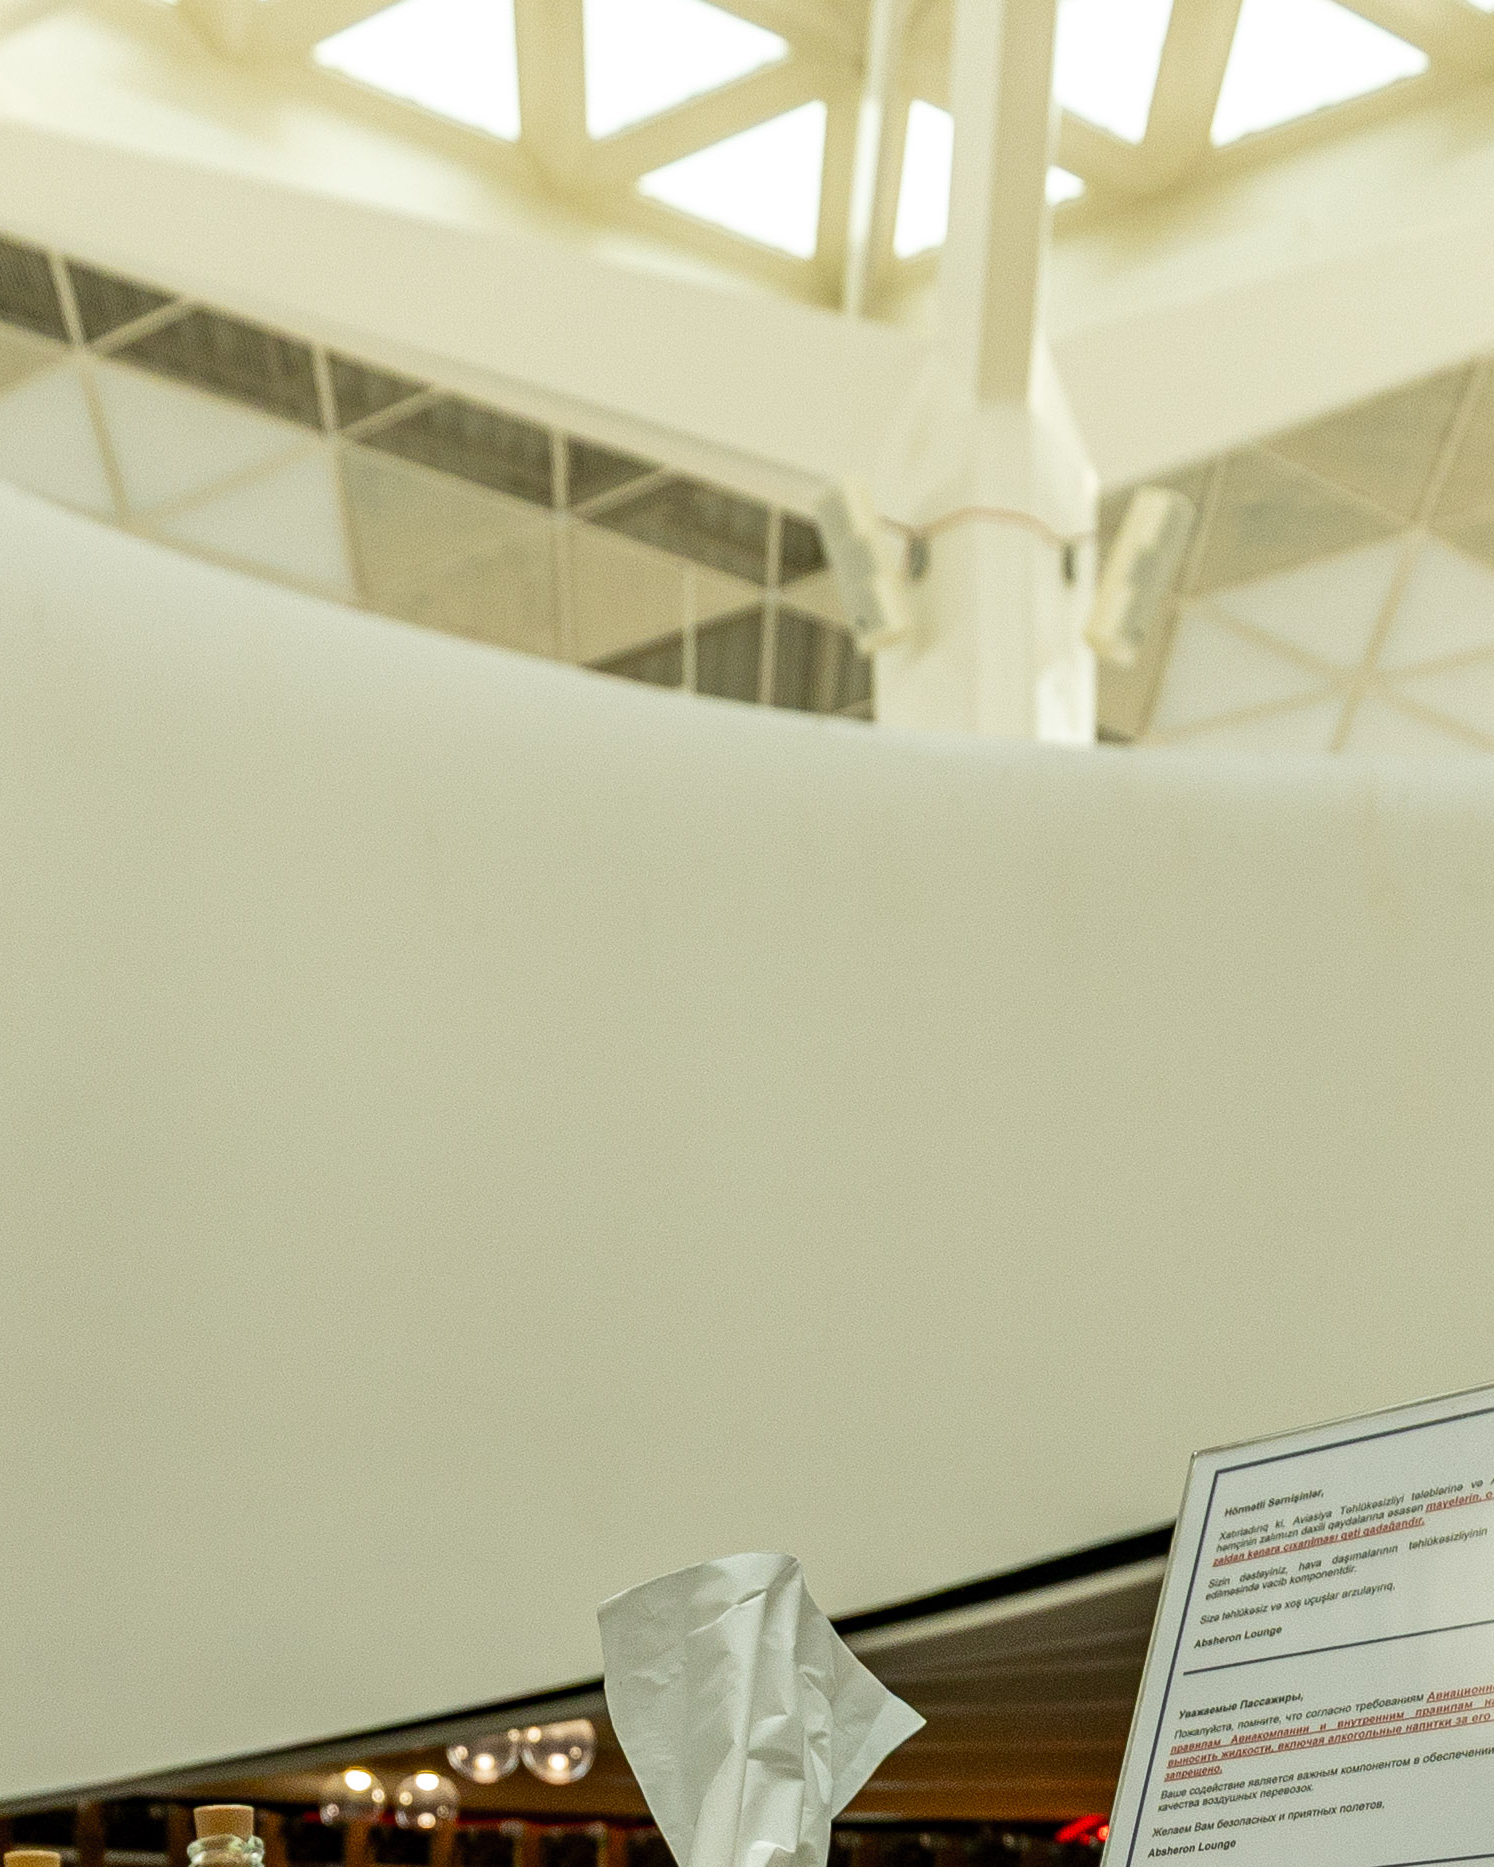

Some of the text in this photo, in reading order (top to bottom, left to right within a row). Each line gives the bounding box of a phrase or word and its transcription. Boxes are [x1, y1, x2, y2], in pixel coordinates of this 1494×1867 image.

[1193, 1625, 1282, 1649] Absheron Lounge
[1178, 1692, 1303, 1720] Уважаемые Пассажиры,
[1146, 1839, 1236, 1858] Absheron Lounge
